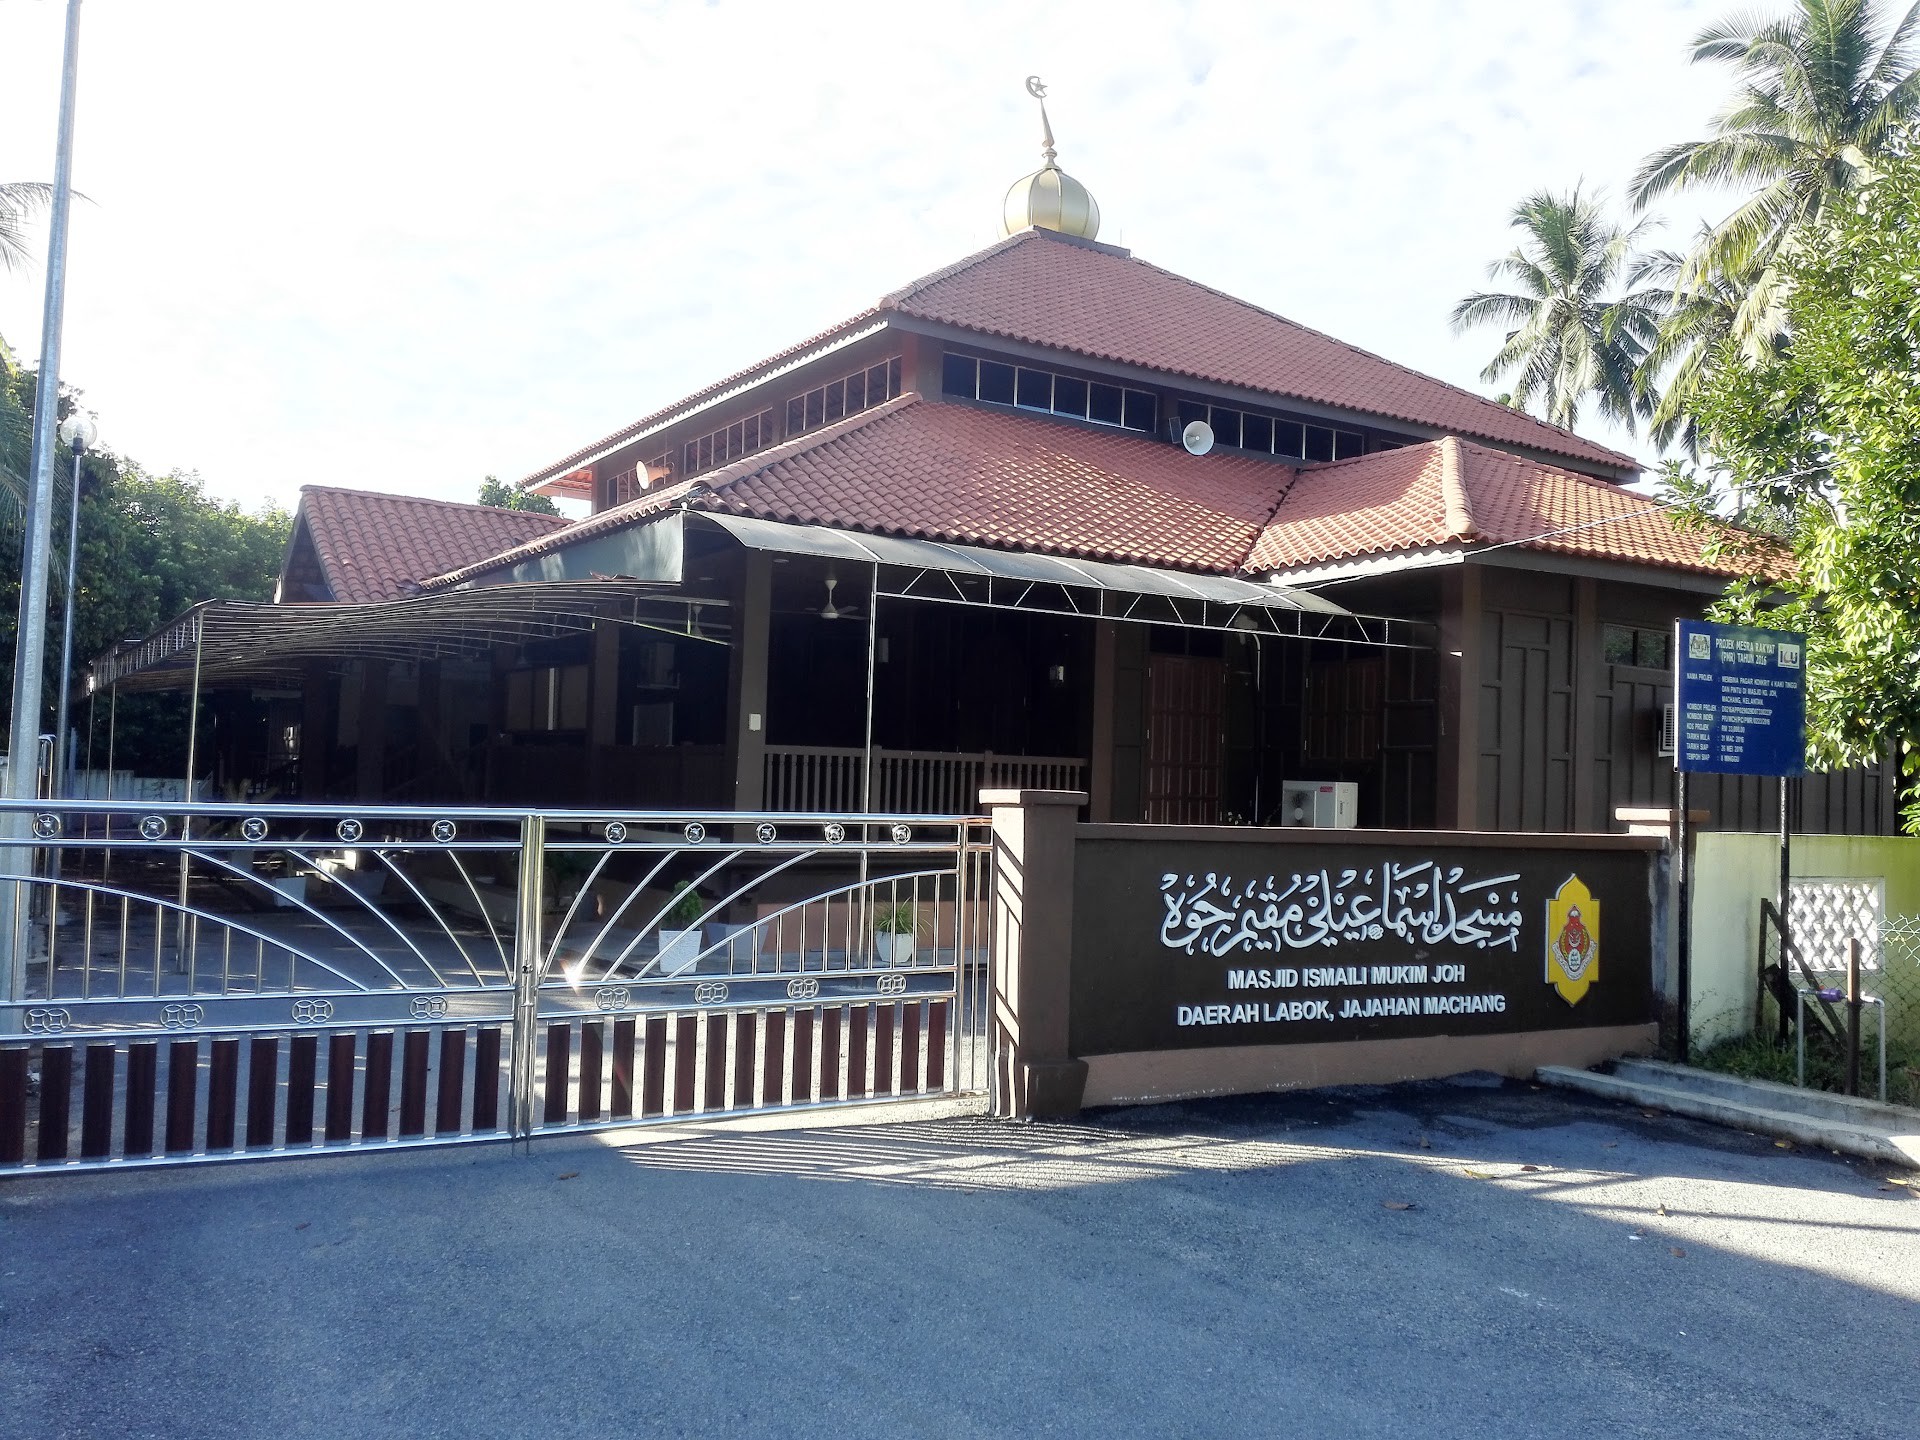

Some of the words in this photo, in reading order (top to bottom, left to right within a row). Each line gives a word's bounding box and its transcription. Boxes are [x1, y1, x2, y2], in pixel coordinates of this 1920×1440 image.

[1716, 638, 1734, 650] PROJEK
[1736, 640, 1754, 652] MESRA
[1756, 642, 1775, 654] RAKYAT
[1721, 651, 1735, 664] (PMR)
[1737, 652, 1754, 664] TAHUN
[1755, 655, 1767, 666] 2016
[1687, 672, 1698, 680] NAMA
[1699, 673, 1713, 681] PROJEK
[1227, 968, 1299, 990] MASJID
[1302, 966, 1368, 988] ISMAILI
[1370, 964, 1428, 986] MUKIM
[1430, 964, 1466, 984] JOH
[1177, 1002, 1260, 1027] DAERAH
[1262, 999, 1335, 1023] LABOK,
[1337, 996, 1421, 1020] JAJAHAN
[1422, 993, 1506, 1016] MACHANG
